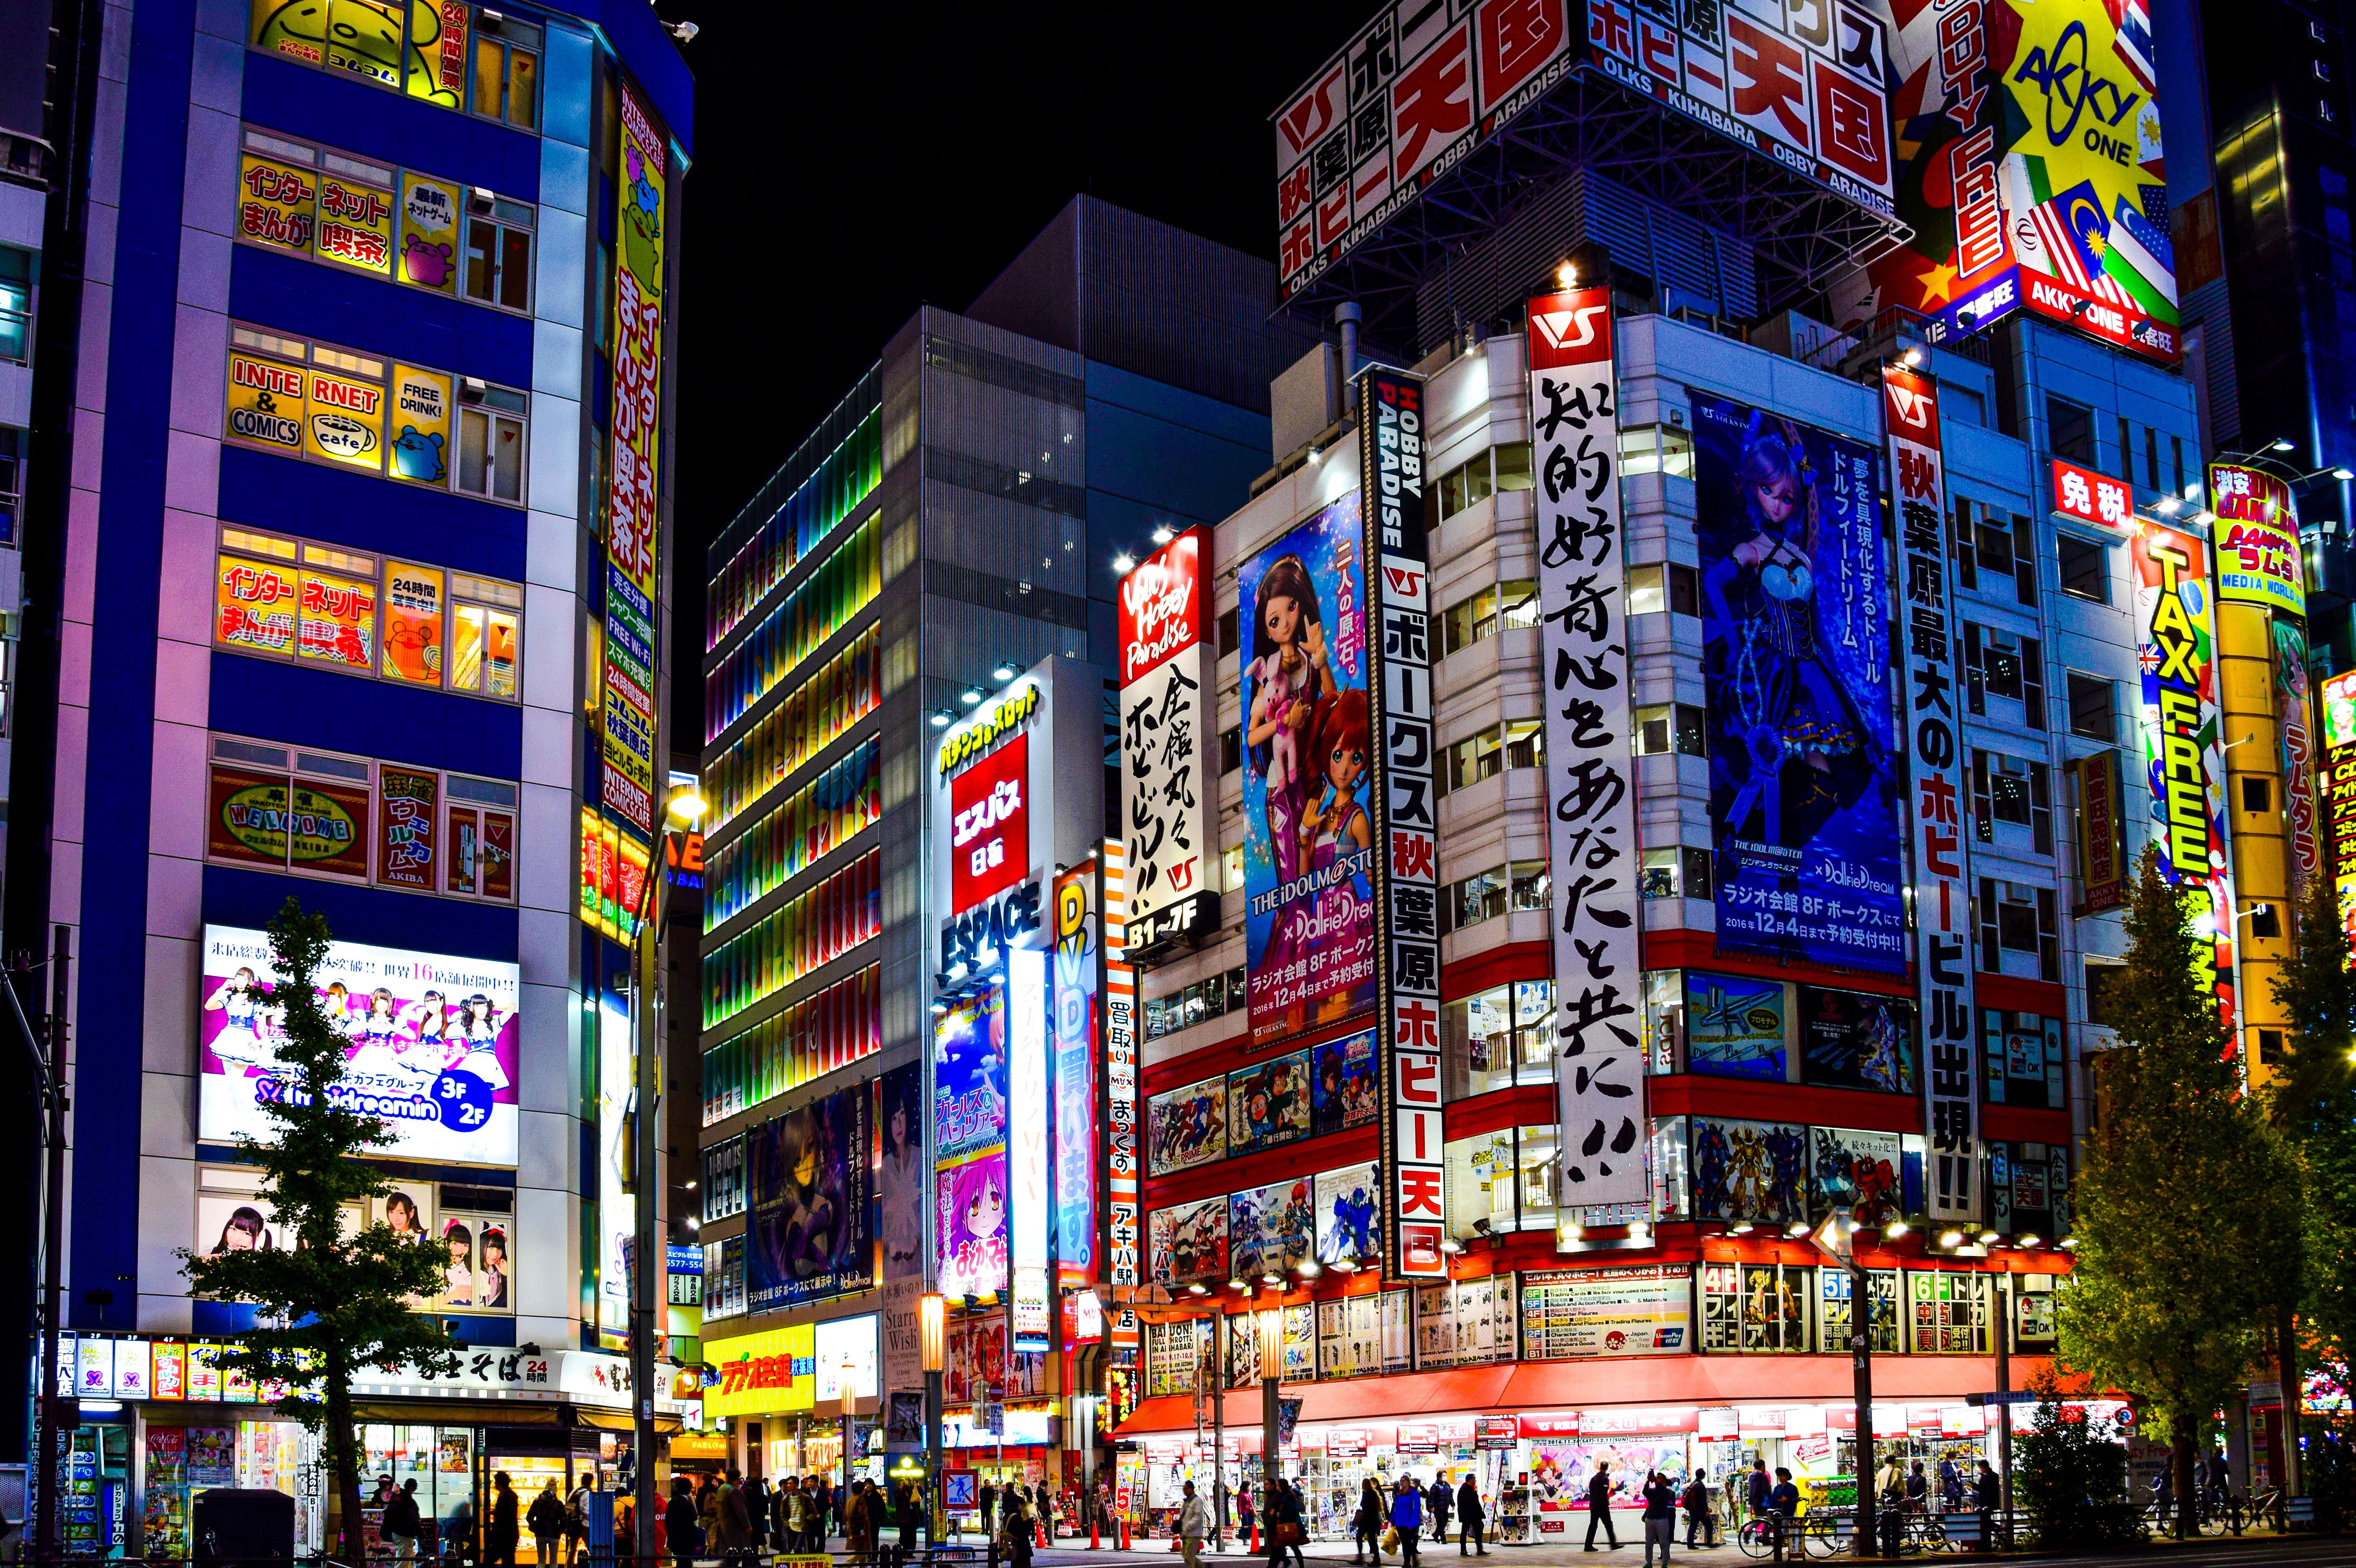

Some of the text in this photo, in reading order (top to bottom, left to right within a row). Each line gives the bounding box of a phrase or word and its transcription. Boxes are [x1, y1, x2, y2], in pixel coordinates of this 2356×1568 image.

[440, 1, 466, 91] 24時間営業
[329, 52, 396, 83] コムコム
[1939, 4, 1989, 132] DUTY
[1592, 48, 1895, 215] VOLKS AKIHABARA HOBBY PARADISE
[1279, 97, 1388, 223] 秋葉原
[2084, 129, 2132, 167] ONE
[1282, 53, 1571, 298] VOLKS AKIHABARA HOBBY PARADISE
[415, 186, 446, 208] 最新
[1951, 127, 2003, 278] FREE
[408, 202, 451, 226] ネットゲーム
[2086, 306, 2125, 334] ONE
[256, 392, 277, 414] &
[400, 396, 442, 419] DRINK!
[404, 383, 439, 402] FREE
[233, 407, 300, 446] COMICS
[610, 267, 639, 567] まんが喫茶
[1715, 414, 1737, 429] VOLKS
[320, 432, 359, 449] cafe
[1400, 387, 1421, 499] HOBBY
[1378, 381, 1402, 548] PARADISE
[2061, 470, 2127, 527] 免税
[2217, 471, 2250, 495] 激安
[1833, 451, 1859, 647] ドルフィードリーム
[1852, 458, 1880, 684] 夢を具現化するドール
[393, 577, 436, 598] 24時間
[393, 593, 434, 613] 営業中!
[614, 572, 648, 617] 完全分煙
[2222, 574, 2294, 601] MEDIA WORLD
[609, 593, 652, 644] シャワー完備
[2148, 544, 2197, 685] TAX
[609, 617, 651, 667] FREE Wi-Fi
[1127, 617, 1192, 680] Paradise
[608, 641, 645, 685] スマホ充電
[608, 666, 650, 716] 24時間営業
[608, 690, 650, 738] コムコム
[607, 710, 649, 763] 秋葉原店
[939, 685, 1039, 775] パチンコ&スロット
[604, 738, 650, 790] 当ビル5F受付
[1159, 664, 1199, 850] 全館丸々
[383, 774, 435, 804] 麻雀
[2161, 690, 2210, 875] FREE
[2286, 723, 2317, 872] ラムタラ
[230, 804, 349, 842] WELCOME
[954, 780, 1021, 848] エスパス
[294, 840, 329, 853] AKIBA
[1735, 840, 1749, 850] THE
[389, 872, 424, 884] AKIBA
[1741, 858, 1799, 872] シンデレラガールズ
[1252, 888, 1280, 917] THE
[1724, 884, 1900, 926] ラジオ会館 8F ボークスにて
[941, 881, 1040, 973] ESPACE
[211, 942, 268, 960] 来店総数
[1252, 959, 1306, 993] ラジオ会館
[1311, 951, 1327, 972] 8F
[1110, 1000, 1133, 1066] 買取り
[1263, 1023, 1278, 1035] VOLKS
[2027, 1063, 2039, 1073] OK
[441, 1078, 466, 1099] 3F
[460, 1103, 485, 1125] 2F
[938, 1112, 997, 1144] パンツァー
[1111, 1099, 1132, 1174] まっくす
[1852, 1140, 1896, 1153] 続々キット化!!
[1181, 1147, 1201, 1162] PRIME
[941, 1172, 951, 1288] 魔法もあるんだよ
[673, 1276, 681, 1303] ガラス交換
[689, 1276, 699, 1303] 液晶交換
[750, 1289, 773, 1303] ラジオ会館
[775, 1287, 782, 1297] 8F
[886, 1280, 919, 1299] 水瀬いのり
[1706, 1268, 1737, 1292] 4F
[886, 1308, 918, 1333] Starry
[2039, 1323, 2050, 1333] OK
[889, 1329, 917, 1351] Wish
[1152, 1338, 1165, 1346] FULL
[527, 1361, 547, 1372] 24
[527, 1373, 547, 1383] 時間
[723, 1353, 792, 1395] ラジオ会館
[791, 1355, 815, 1376] 秋葉原
[657, 1376, 666, 1387] 24
